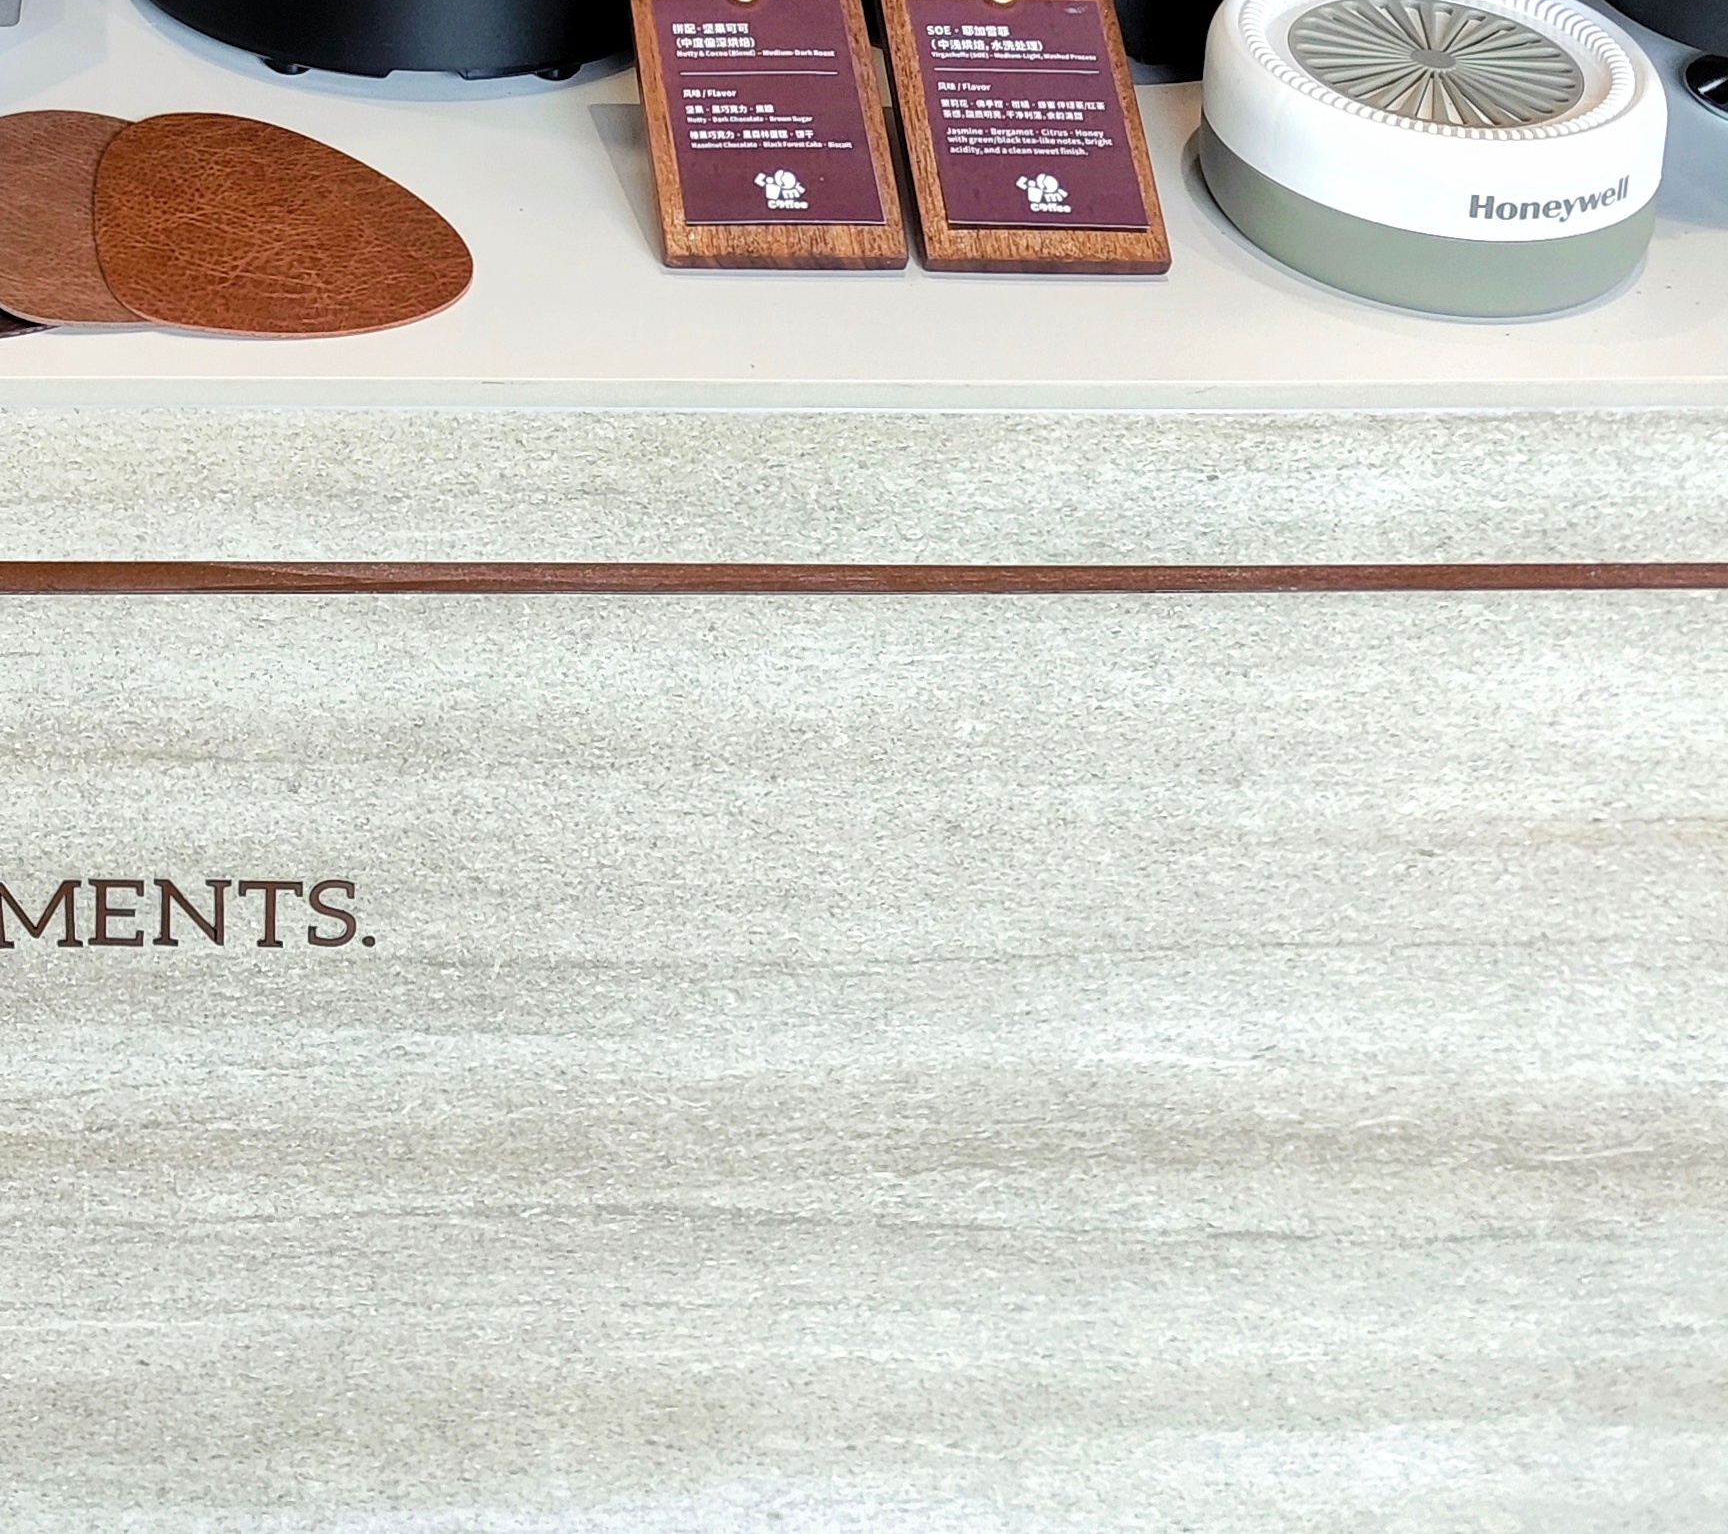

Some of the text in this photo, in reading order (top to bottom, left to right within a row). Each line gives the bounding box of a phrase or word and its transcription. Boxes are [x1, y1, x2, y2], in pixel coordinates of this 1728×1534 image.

[926, 25, 952, 36] SOE
[962, 82, 992, 92] Flavor
[707, 88, 737, 98] Flavor
[946, 127, 1104, 139] Jasmine Bergamot Citrus Honey
[947, 136, 1113, 148] with green/black tea-like notes, bright
[949, 146, 984, 155] acidity,
[984, 146, 1001, 154] and
[1008, 147, 1033, 155] clean
[1033, 147, 1060, 155] sweet
[1060, 147, 1089, 156] finish.
[1468, 174, 1630, 223] Honeywell
